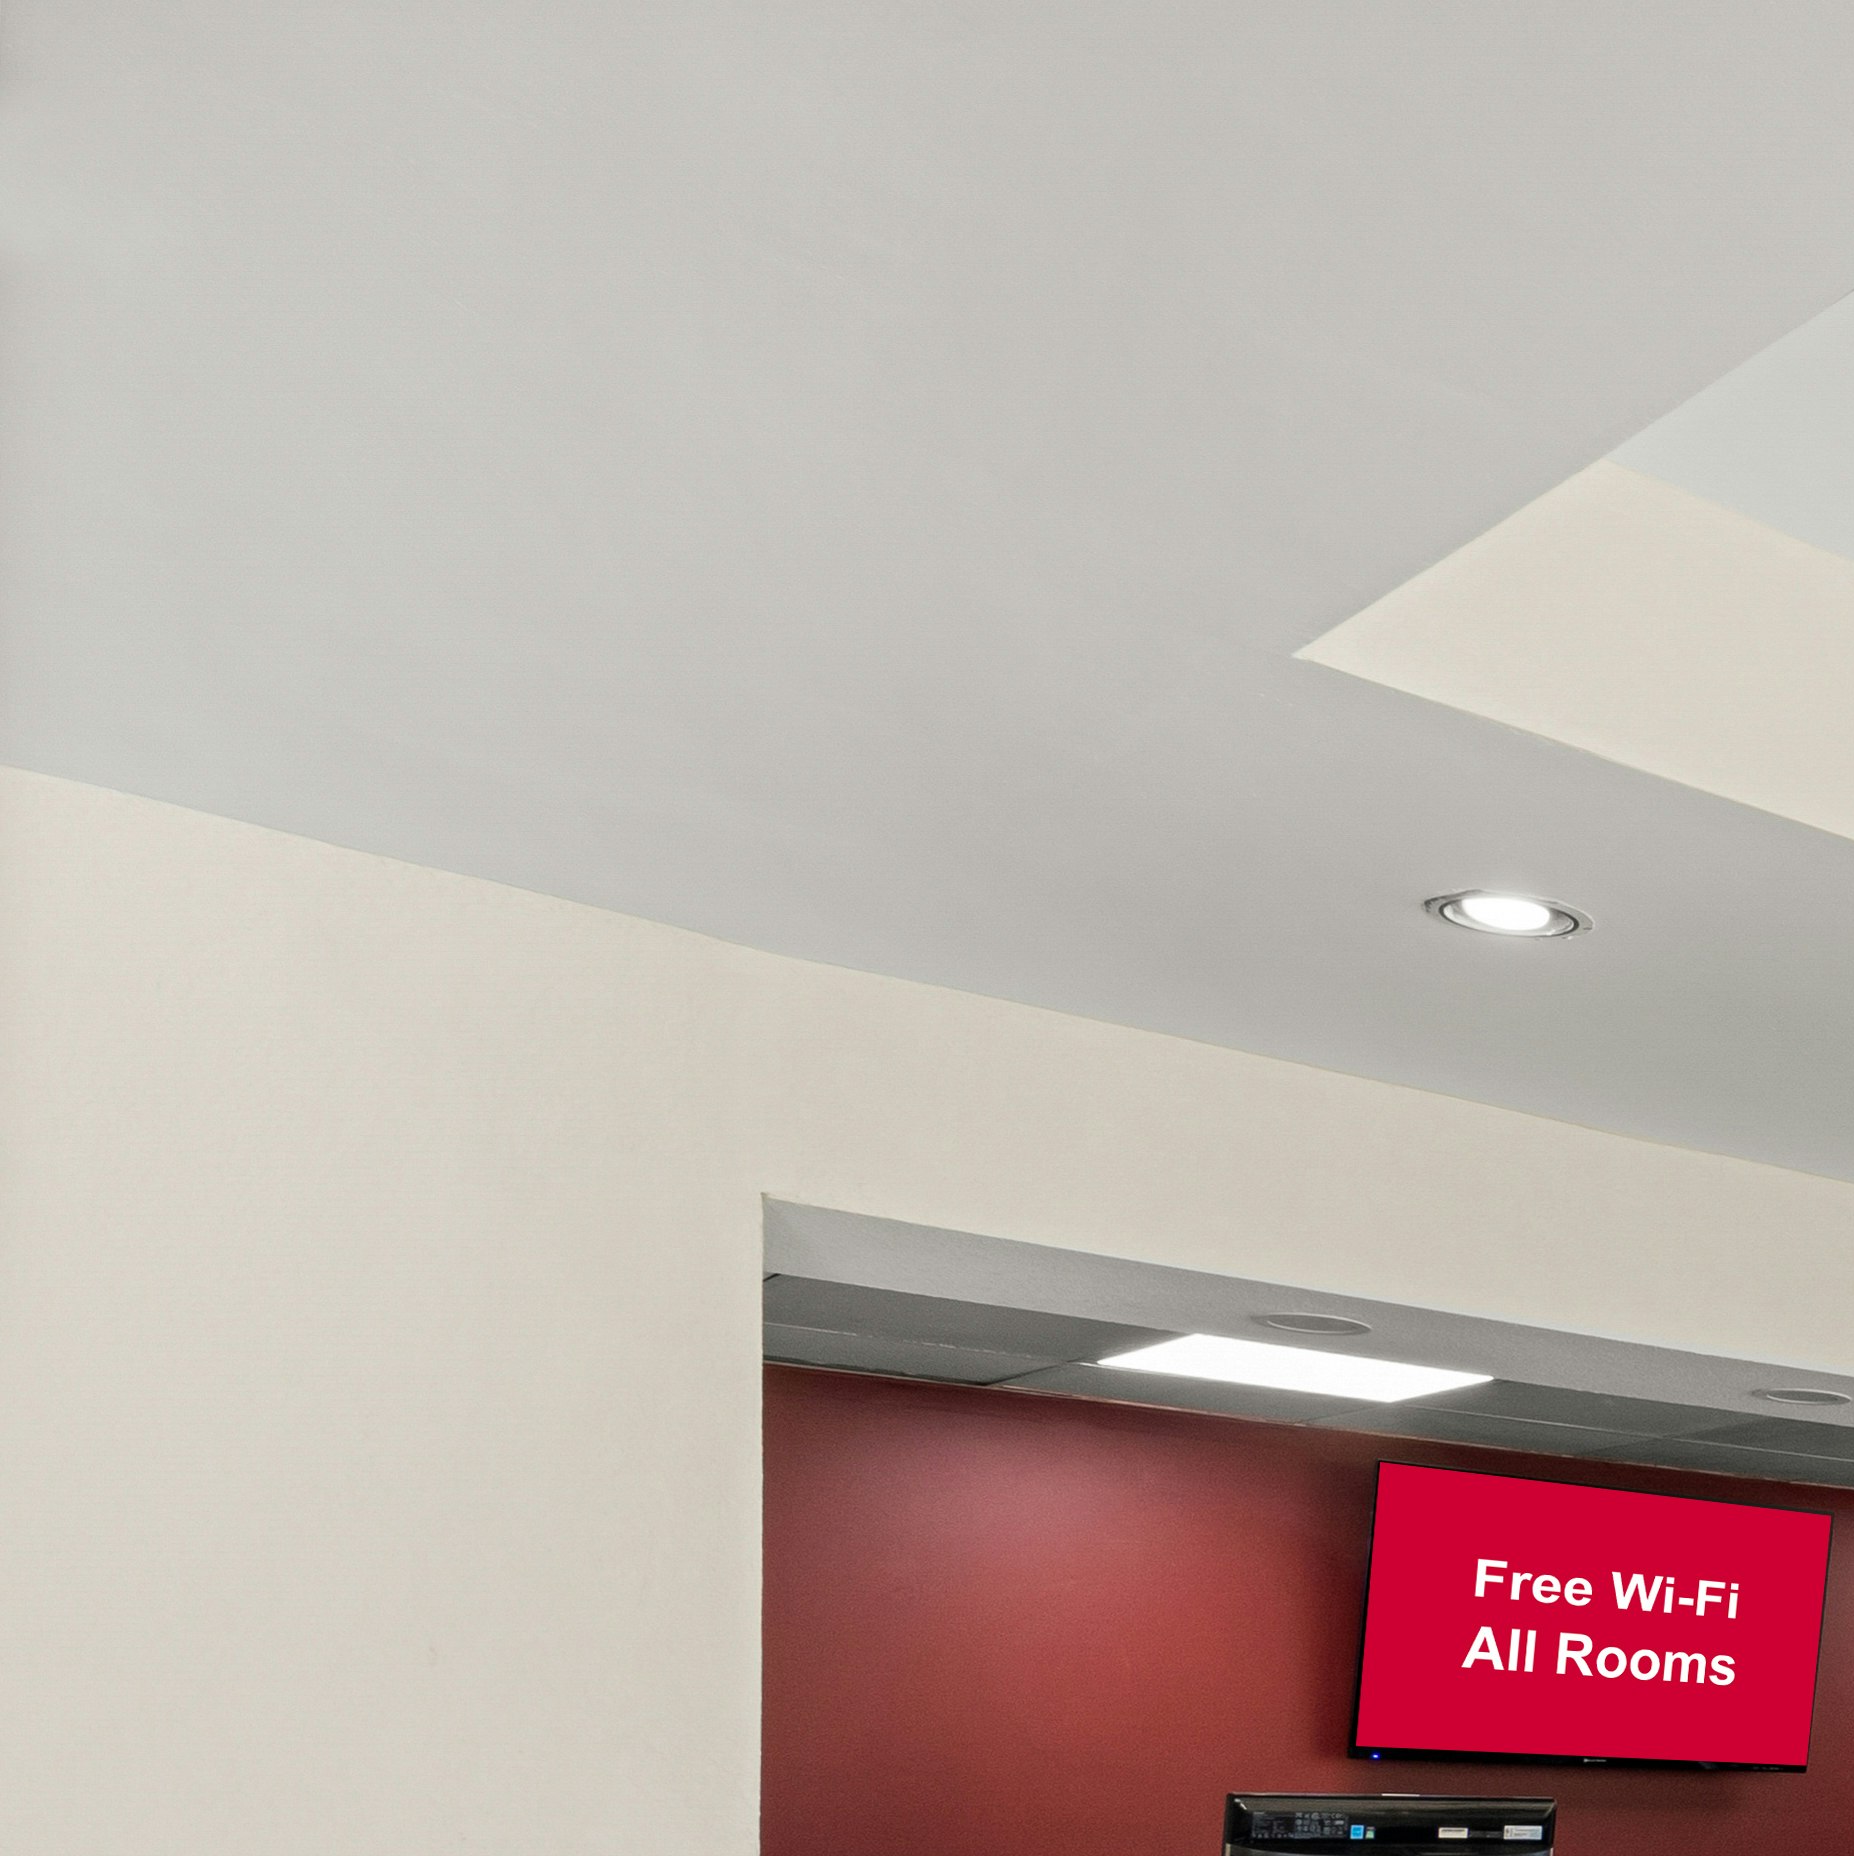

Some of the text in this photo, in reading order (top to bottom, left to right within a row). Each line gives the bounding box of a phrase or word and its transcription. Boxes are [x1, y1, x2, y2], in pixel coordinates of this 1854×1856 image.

[1474, 1558, 1740, 1619] Free Wi-Fi
[1461, 1625, 1736, 1686] All Rooms
